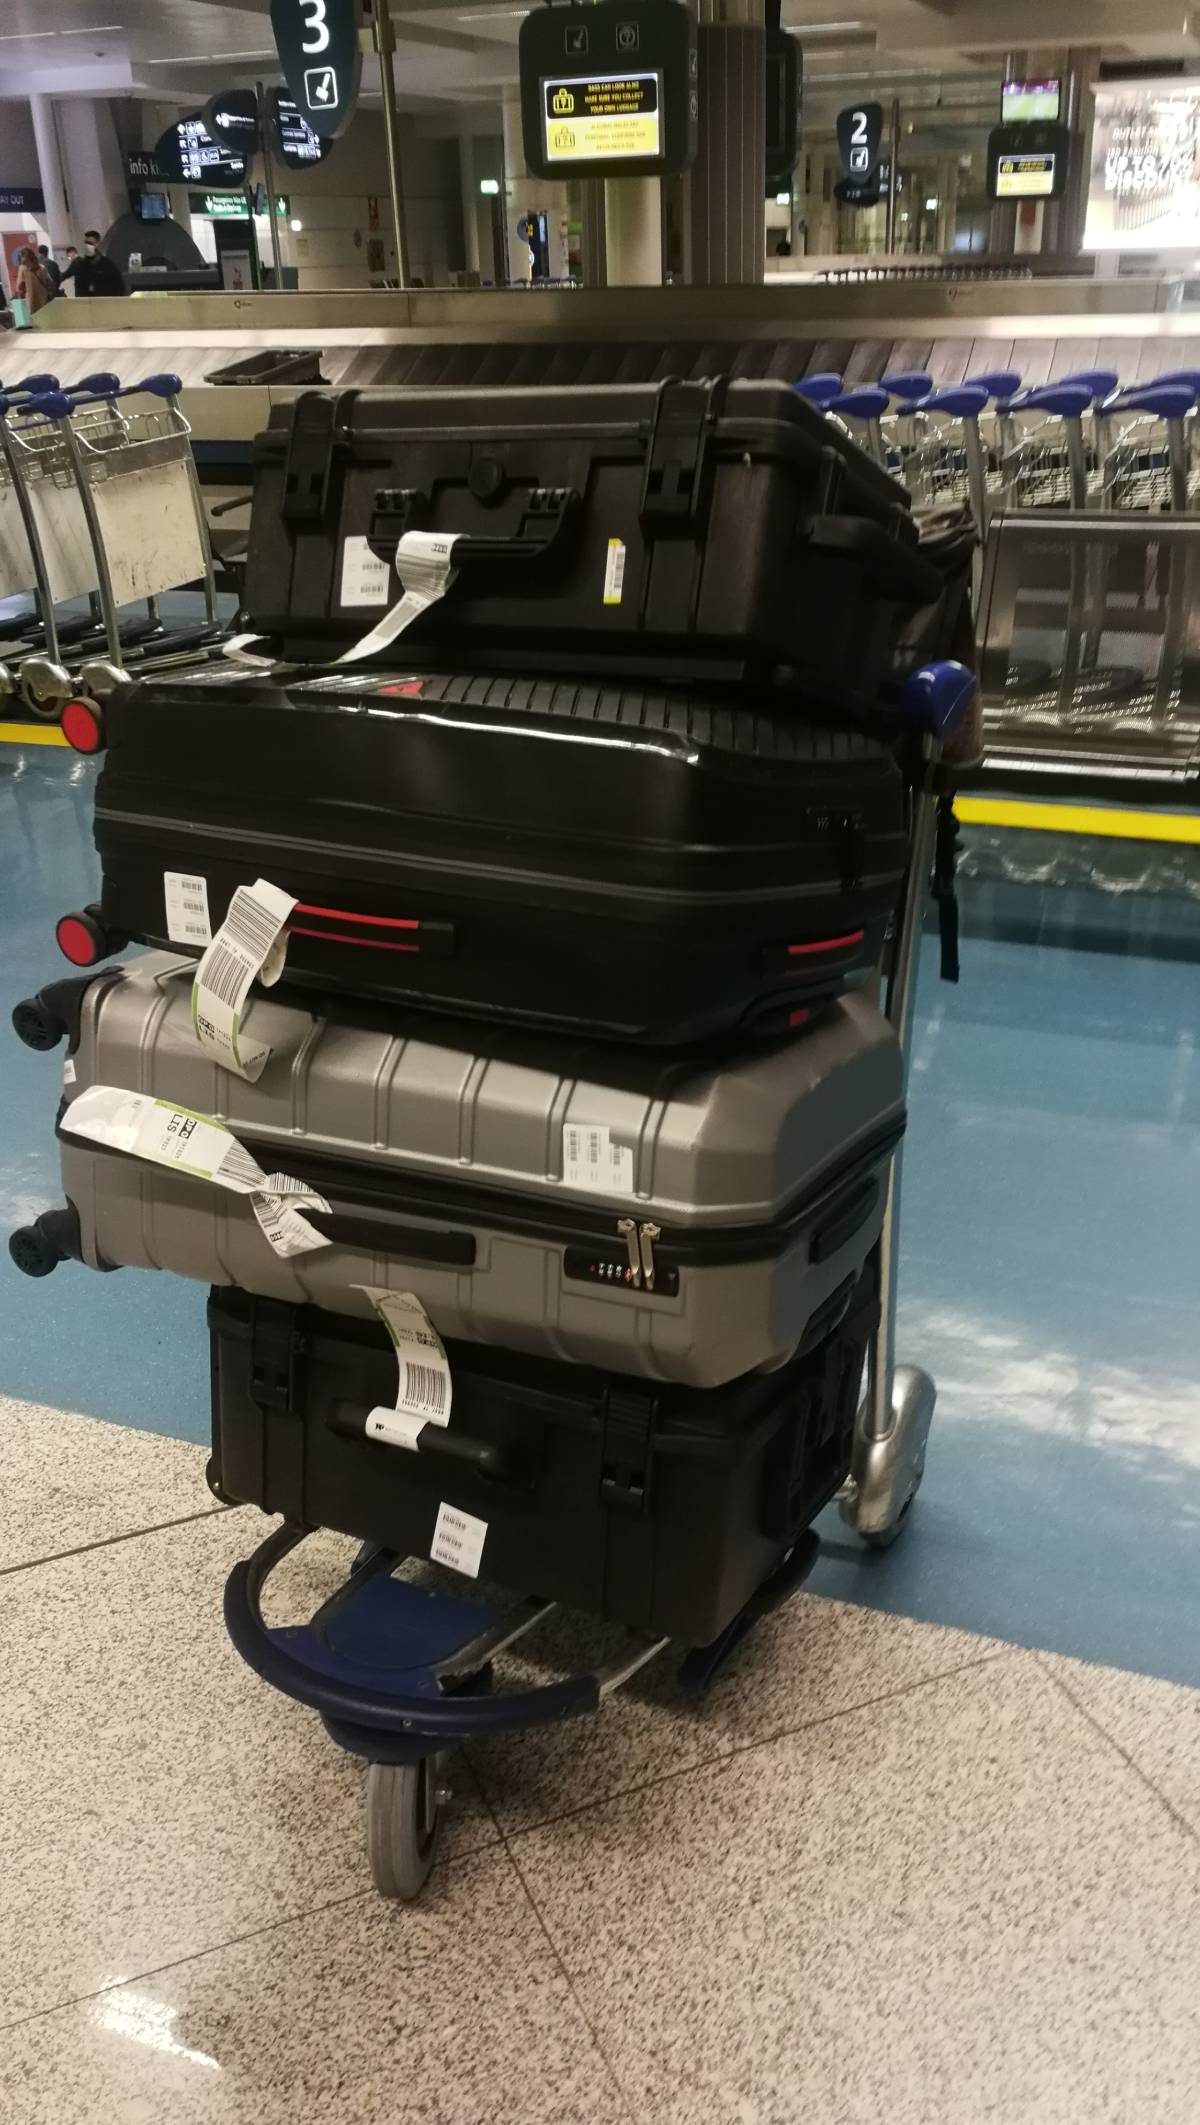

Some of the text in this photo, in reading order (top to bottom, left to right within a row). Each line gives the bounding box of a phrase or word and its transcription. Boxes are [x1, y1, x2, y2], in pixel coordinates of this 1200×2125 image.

[300, 0, 330, 53] 3
[851, 112, 867, 144] 2
[129, 159, 149, 175] info
[167, 1113, 184, 1133] LIS
[178, 1118, 198, 1139] OPO
